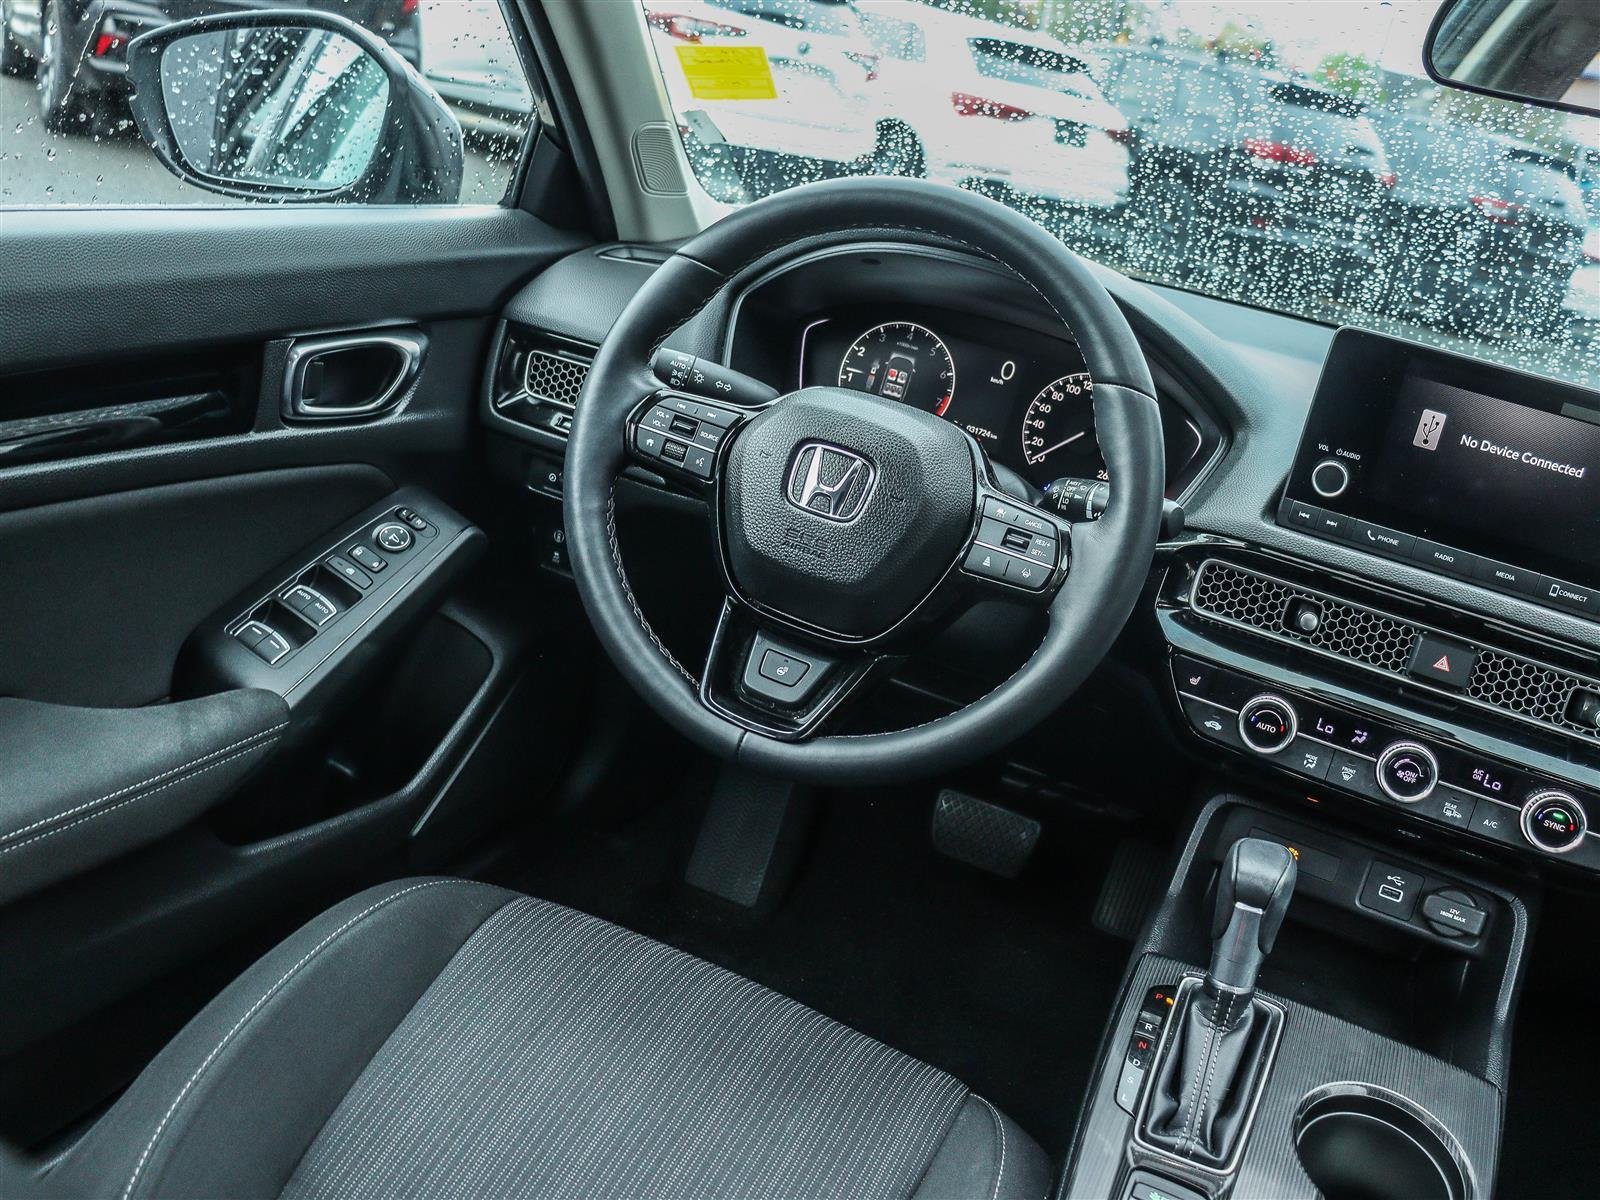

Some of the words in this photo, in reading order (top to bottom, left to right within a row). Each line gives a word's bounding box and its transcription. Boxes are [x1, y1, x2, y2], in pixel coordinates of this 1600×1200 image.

[880, 333, 887, 342] 3
[857, 346, 866, 356] 2
[929, 347, 937, 356] 5
[670, 360, 685, 369] AUTO
[939, 370, 947, 379] 6
[1001, 360, 1015, 380] 0
[847, 372, 854, 382] 1
[1065, 384, 1080, 394] 100
[1051, 391, 1064, 401] 80
[1039, 403, 1051, 413] 60
[1032, 419, 1045, 429] 40
[700, 431, 719, 441] SOURCE
[1031, 436, 1044, 446] 20
[1318, 443, 1329, 452] VOL
[1342, 450, 1361, 460] AUDIO
[1460, 434, 1478, 449] No
[1480, 440, 1519, 461] Device
[1521, 451, 1585, 479] Connected
[1061, 497, 1070, 505] LO
[1024, 519, 1042, 529] CANCEL
[1377, 534, 1398, 545] PHONE
[1434, 551, 1453, 562] RADIO
[1495, 570, 1515, 581] MEDIA
[297, 589, 311, 599] AUTO
[1558, 589, 1587, 602] CONNECT
[314, 602, 328, 613] AUTO
[1256, 721, 1275, 733] AUTO
[1316, 717, 1333, 734] Lo
[1472, 767, 1484, 776] A/C
[1402, 775, 1417, 784] OFF
[1472, 773, 1483, 782] ON
[1483, 773, 1501, 791] Lo
[1482, 818, 1498, 829] A/C
[1543, 819, 1566, 832] SYNC
[1453, 915, 1466, 923] MAX
[1155, 992, 1164, 1000] P
[1144, 1023, 1153, 1032] R
[1138, 1040, 1148, 1049] N
[1132, 1058, 1141, 1067] D
